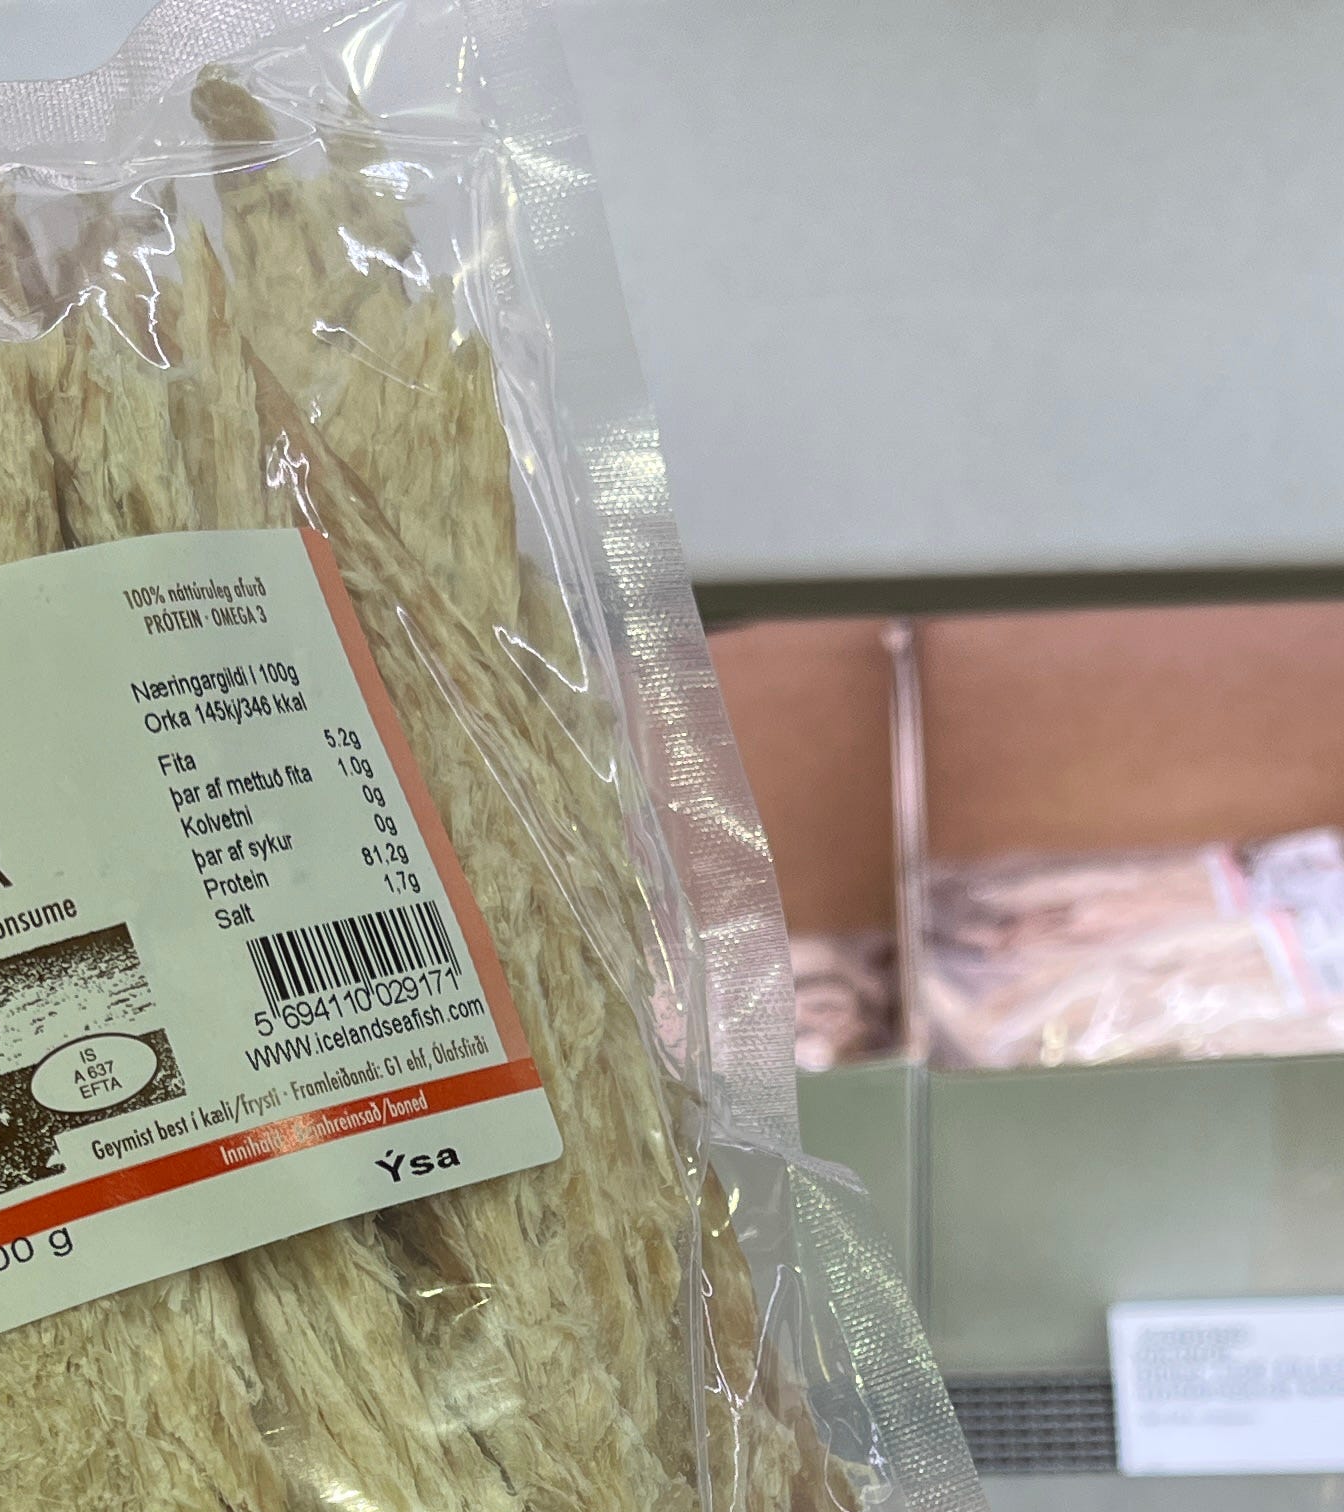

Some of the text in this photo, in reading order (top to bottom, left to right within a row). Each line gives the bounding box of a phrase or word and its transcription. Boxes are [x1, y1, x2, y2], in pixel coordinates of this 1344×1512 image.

[123, 577, 267, 610] 100% náttúruleg afurð
[143, 605, 268, 635] PRÓTEIN OMEGA 3
[131, 665, 249, 704] Næringargildi
[259, 662, 300, 686] 100g
[144, 706, 192, 734] Orka
[272, 691, 308, 714] kkal
[158, 752, 197, 777] Fita
[205, 780, 224, 801] af
[284, 764, 313, 785] fita
[180, 784, 386, 838] Kolvetni 0g
[227, 840, 246, 862] af
[248, 832, 295, 862] sykur
[373, 813, 398, 836] 0g
[203, 842, 410, 900] Protein 81,2g
[214, 871, 421, 930] Salt 1,7g
[254, 1011, 274, 1037] 5
[74, 1060, 114, 1084] A 637
[79, 1048, 97, 1064] IS
[79, 1076, 123, 1100] EFTA
[91, 1126, 154, 1161] Geymist
[156, 1113, 190, 1142] best
[374, 1147, 461, 1183] Ýsa
[49, 1227, 74, 1257] g
